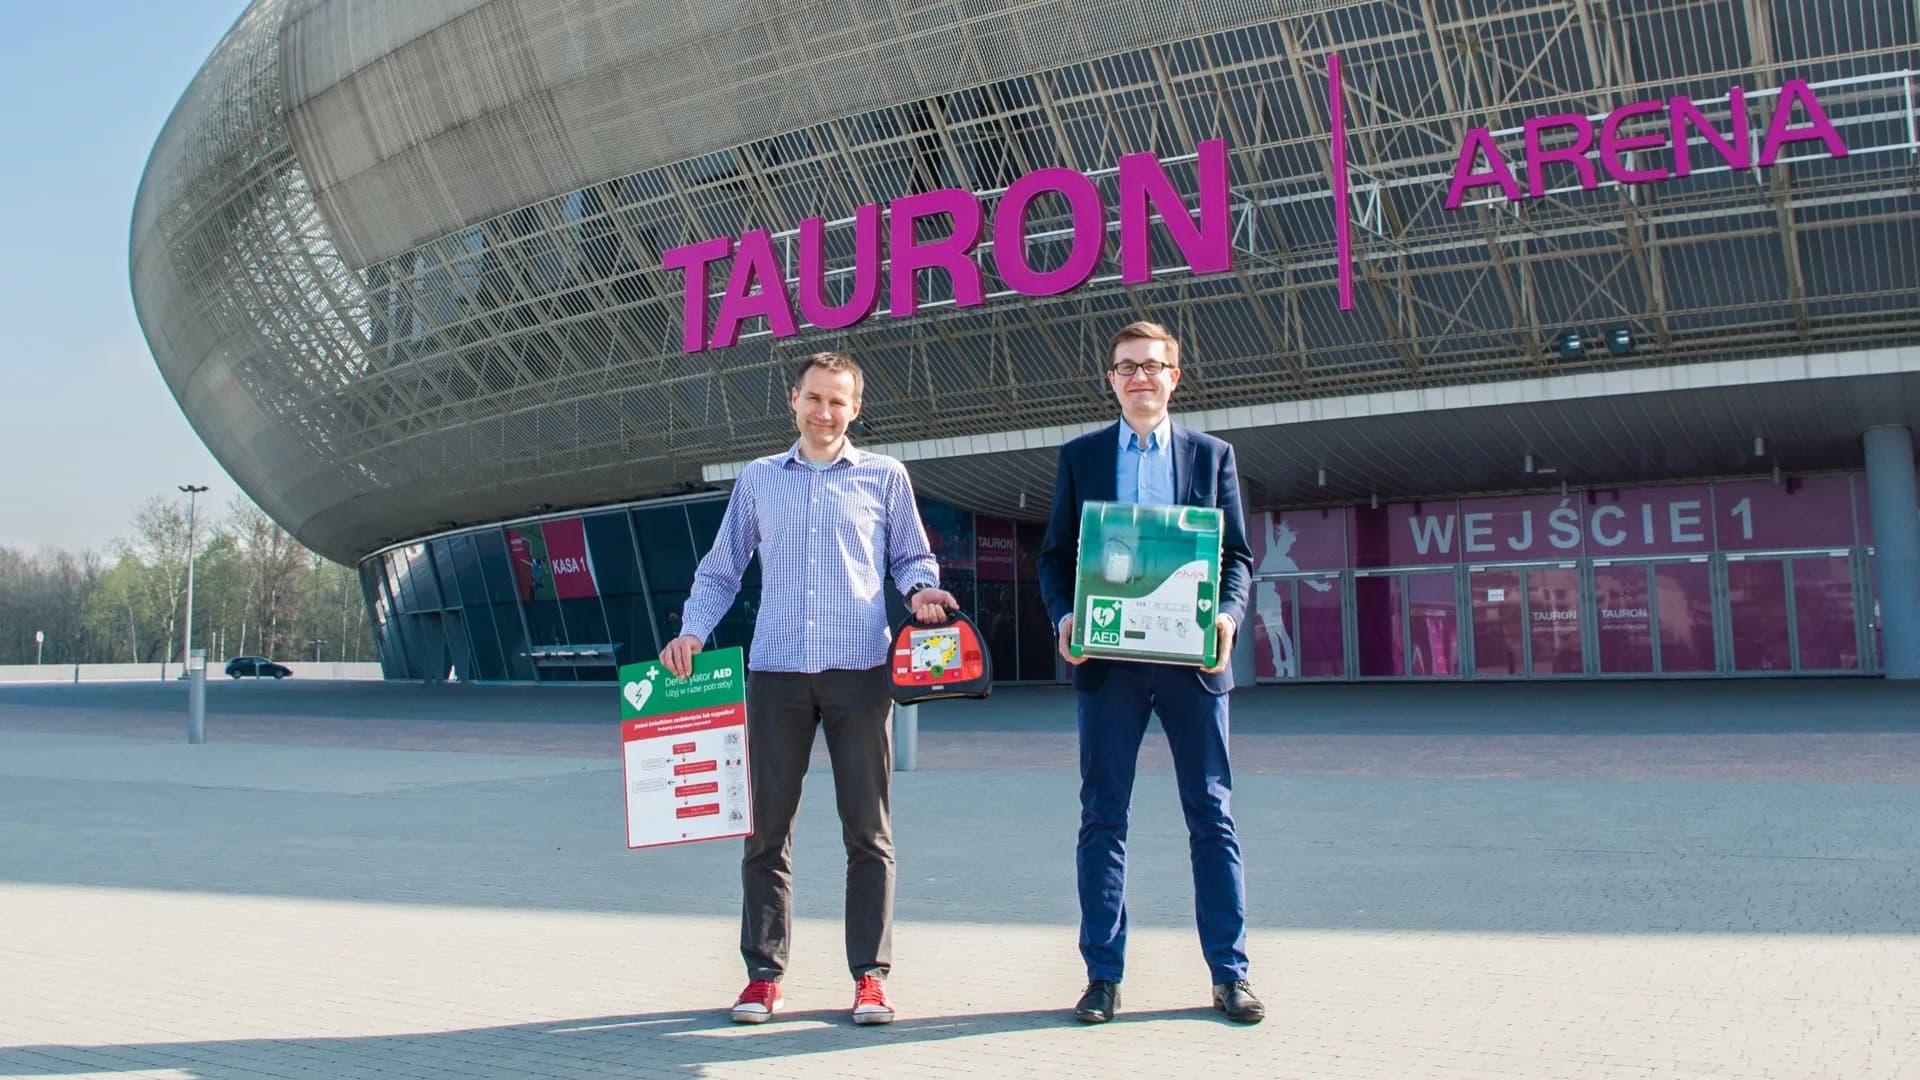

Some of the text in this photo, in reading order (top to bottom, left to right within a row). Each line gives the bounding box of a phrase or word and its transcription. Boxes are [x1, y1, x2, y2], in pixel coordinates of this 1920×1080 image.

[663, 78, 1847, 352] TAURON ARENA
[1409, 498, 1753, 554] WEJŚCIE 1
[978, 536, 1013, 549] TAURON
[552, 556, 586, 574] KASA 1
[1532, 610, 1577, 620] TAURON
[1601, 608, 1647, 618] TAURON
[1092, 631, 1119, 644] AED
[713, 667, 732, 680] AED
